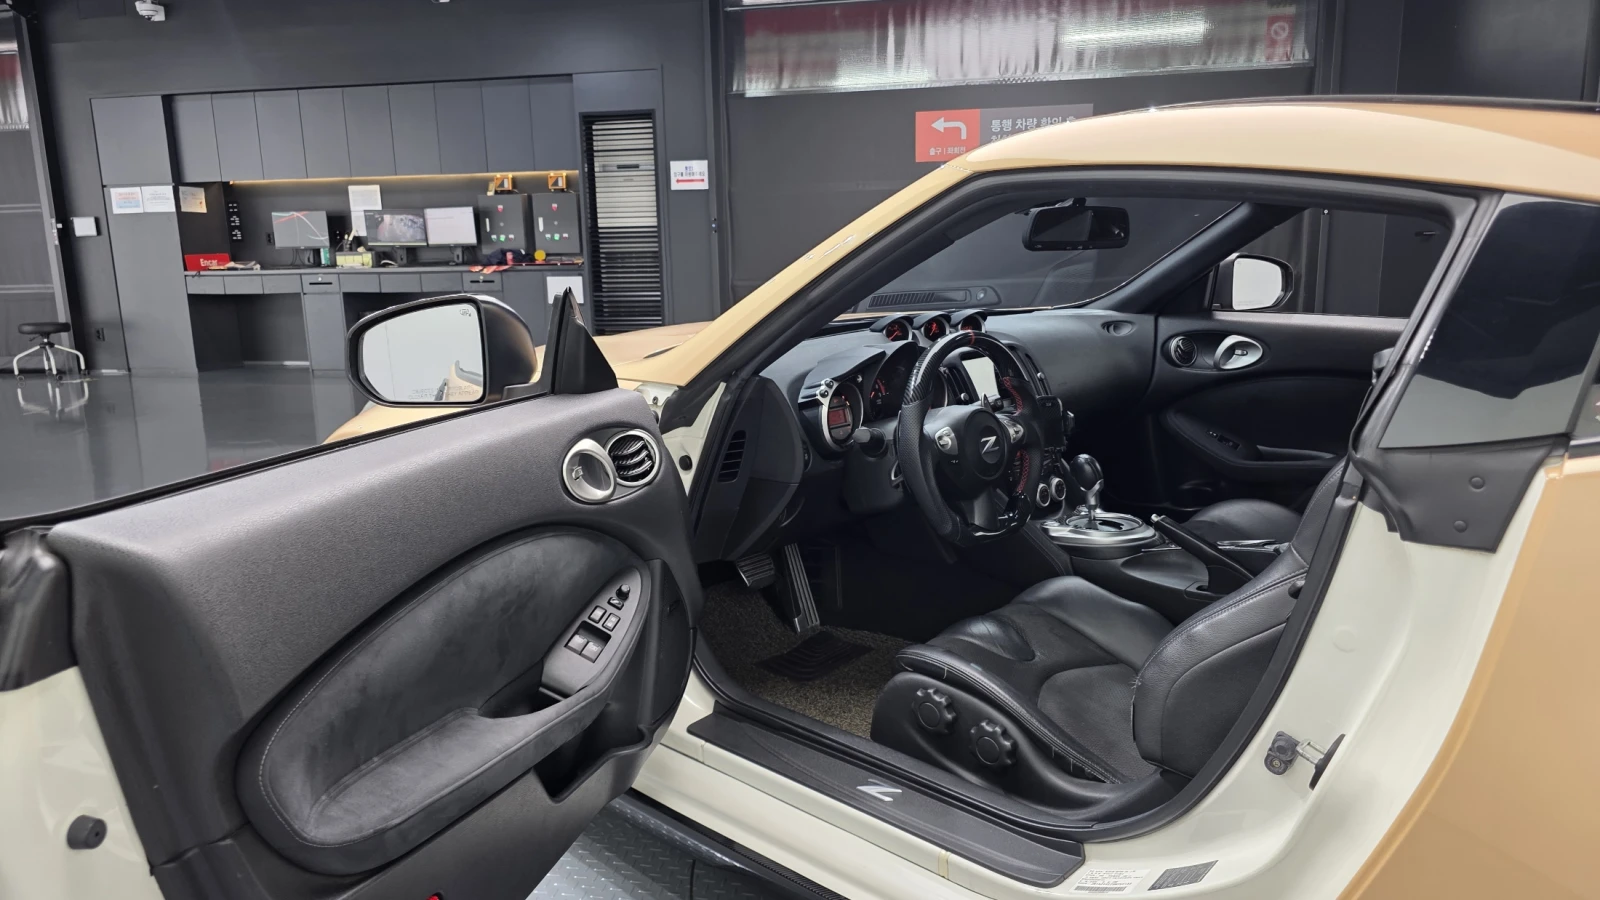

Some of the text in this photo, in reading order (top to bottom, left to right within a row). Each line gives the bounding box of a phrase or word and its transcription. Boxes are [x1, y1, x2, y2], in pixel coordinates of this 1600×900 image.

[991, 118, 1012, 132] 통행
[1015, 117, 1037, 130] 차량
[929, 147, 941, 155] 출구
